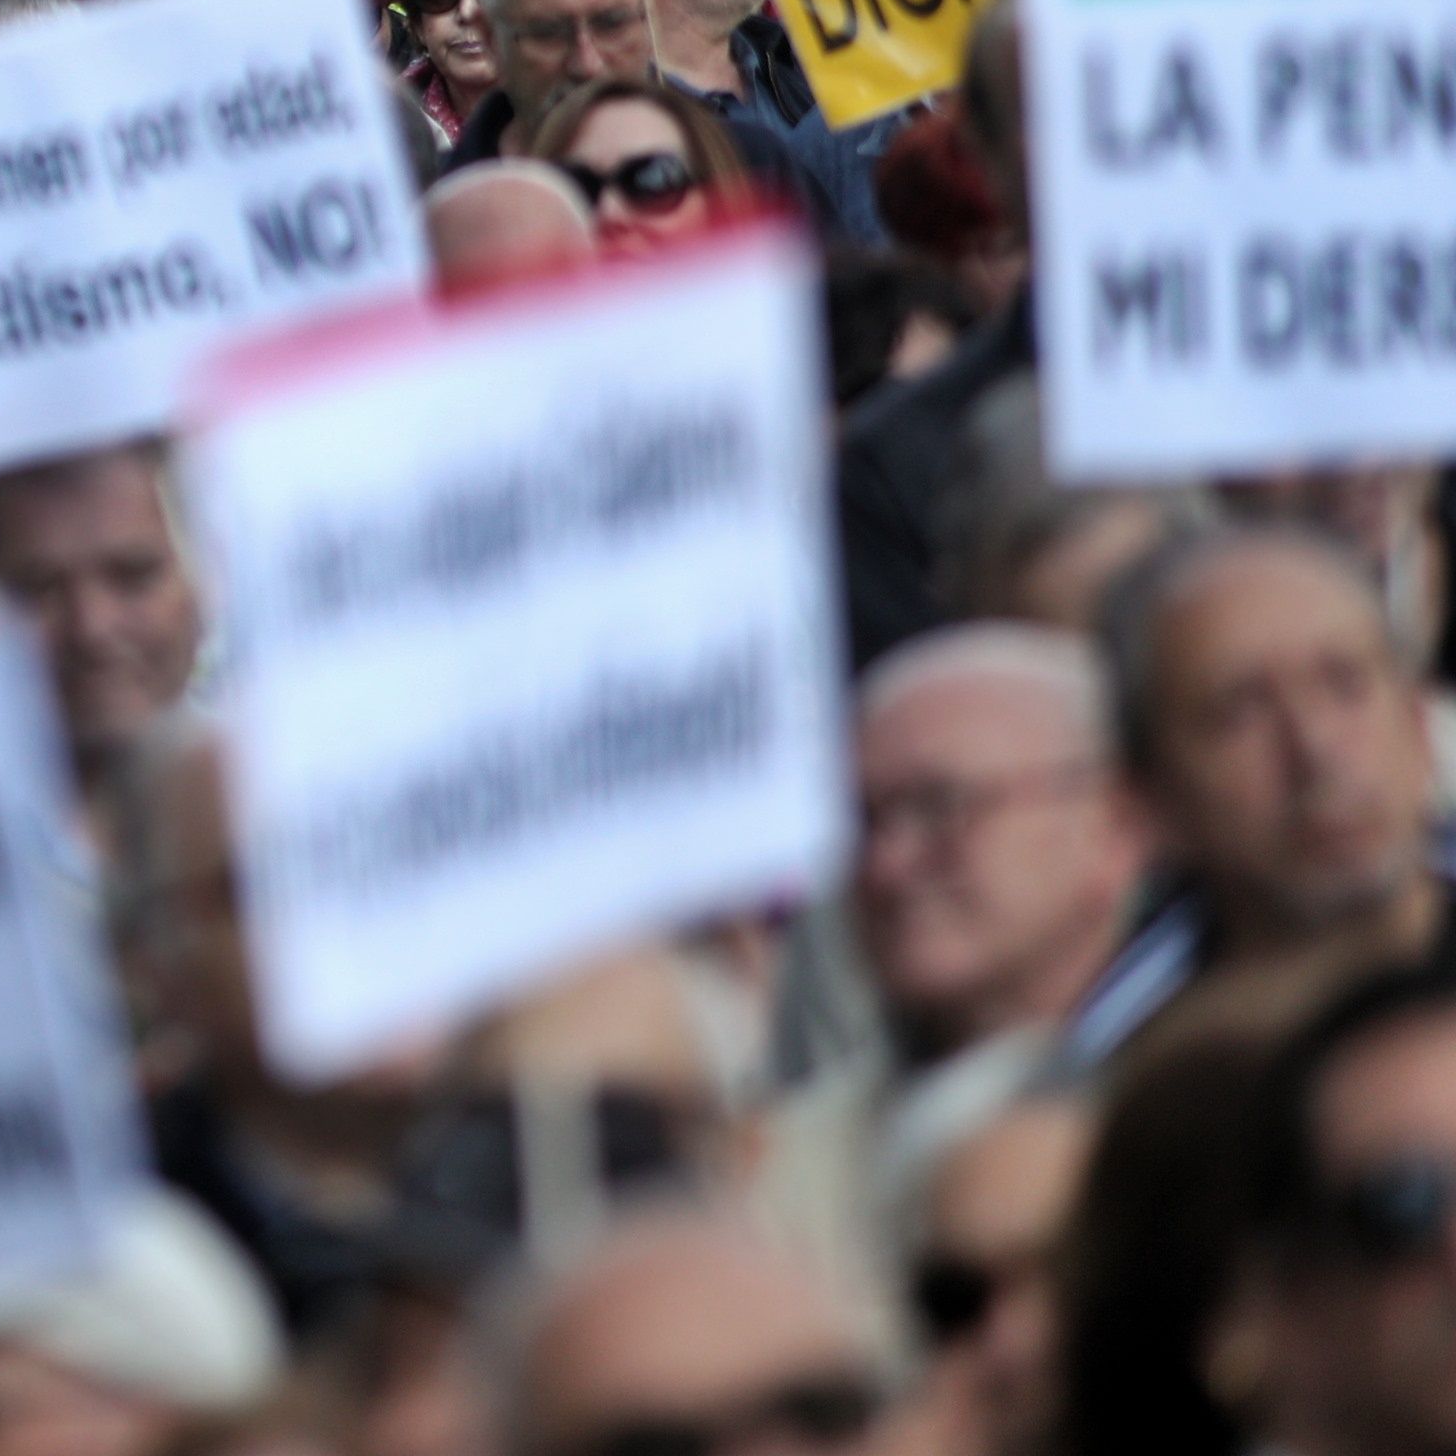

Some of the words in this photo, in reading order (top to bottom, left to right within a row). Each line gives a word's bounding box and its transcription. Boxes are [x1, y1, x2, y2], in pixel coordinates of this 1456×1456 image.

[102, 92, 194, 202] por
[206, 50, 353, 163] edad,
[1082, 32, 1224, 172] LA
[1260, 28, 1456, 164] PEN
[242, 175, 387, 294] NO!
[1089, 242, 1209, 376] MI
[1238, 231, 1456, 376] DER
